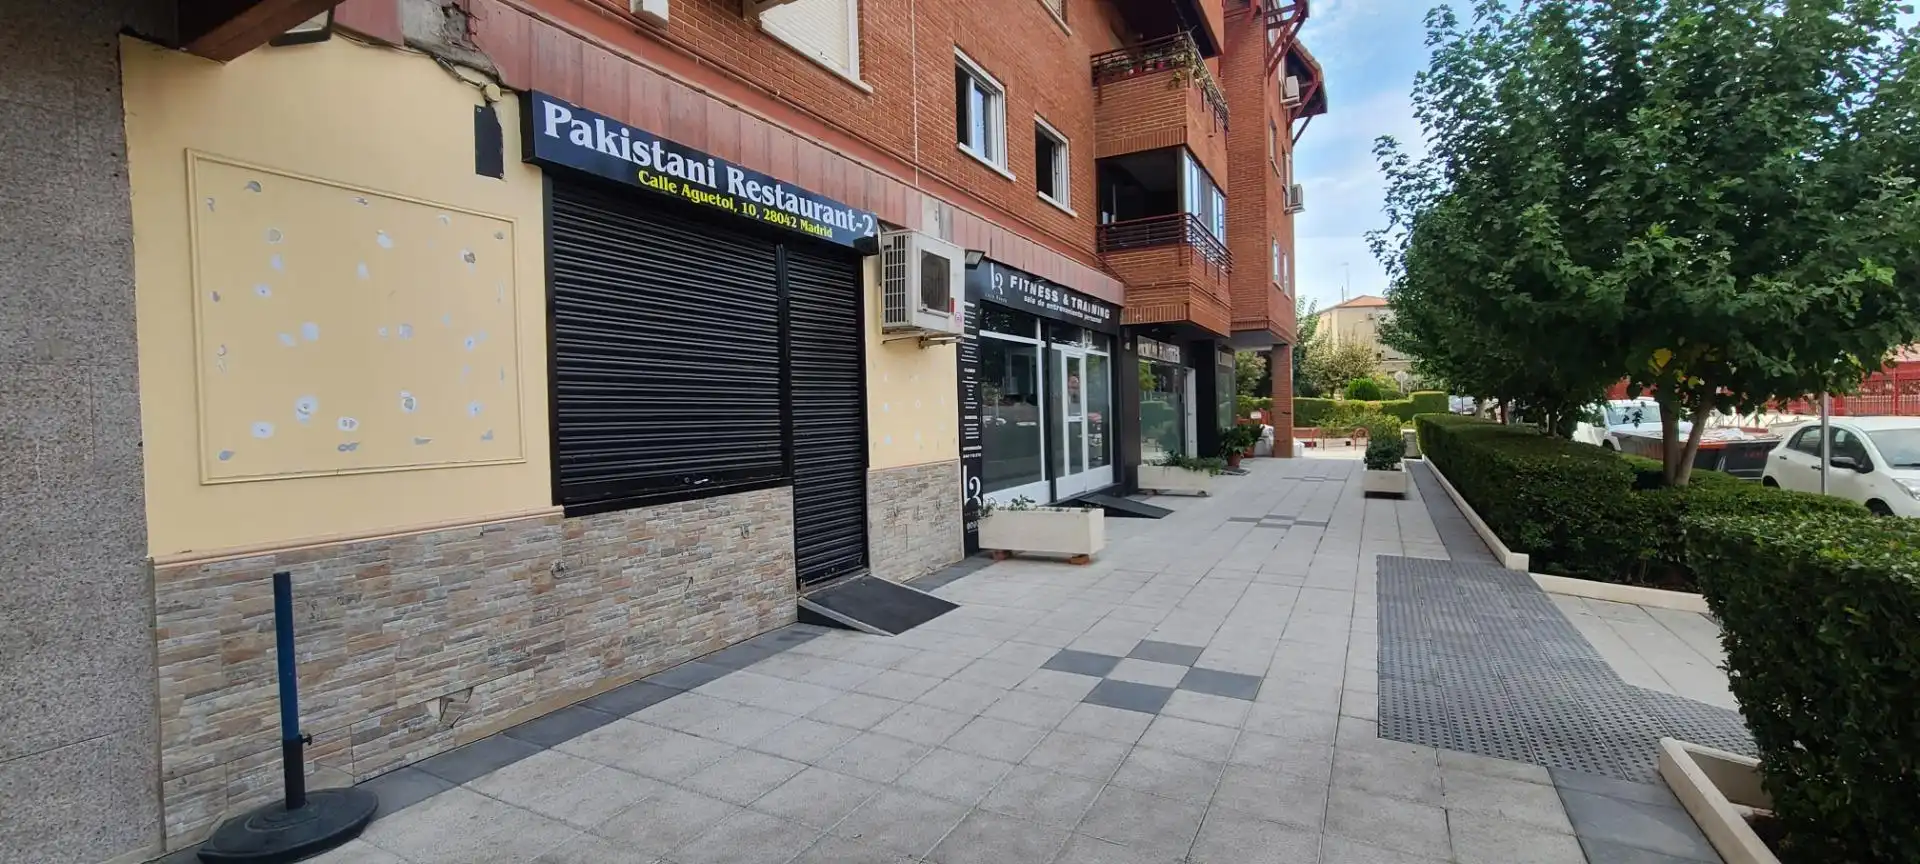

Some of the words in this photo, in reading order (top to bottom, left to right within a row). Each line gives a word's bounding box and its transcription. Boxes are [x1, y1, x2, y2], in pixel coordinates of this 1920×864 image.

[542, 100, 717, 189] Pakistani
[727, 165, 874, 238] Restaurant-2
[638, 169, 677, 195] Calle
[681, 183, 738, 214] Aguetol,
[742, 202, 760, 220] 10,
[763, 206, 797, 229] 28042
[800, 219, 833, 238] Madrid
[1009, 275, 1058, 302] FITNESS
[1063, 293, 1069, 306] &
[1071, 297, 1110, 319] TRAINING
